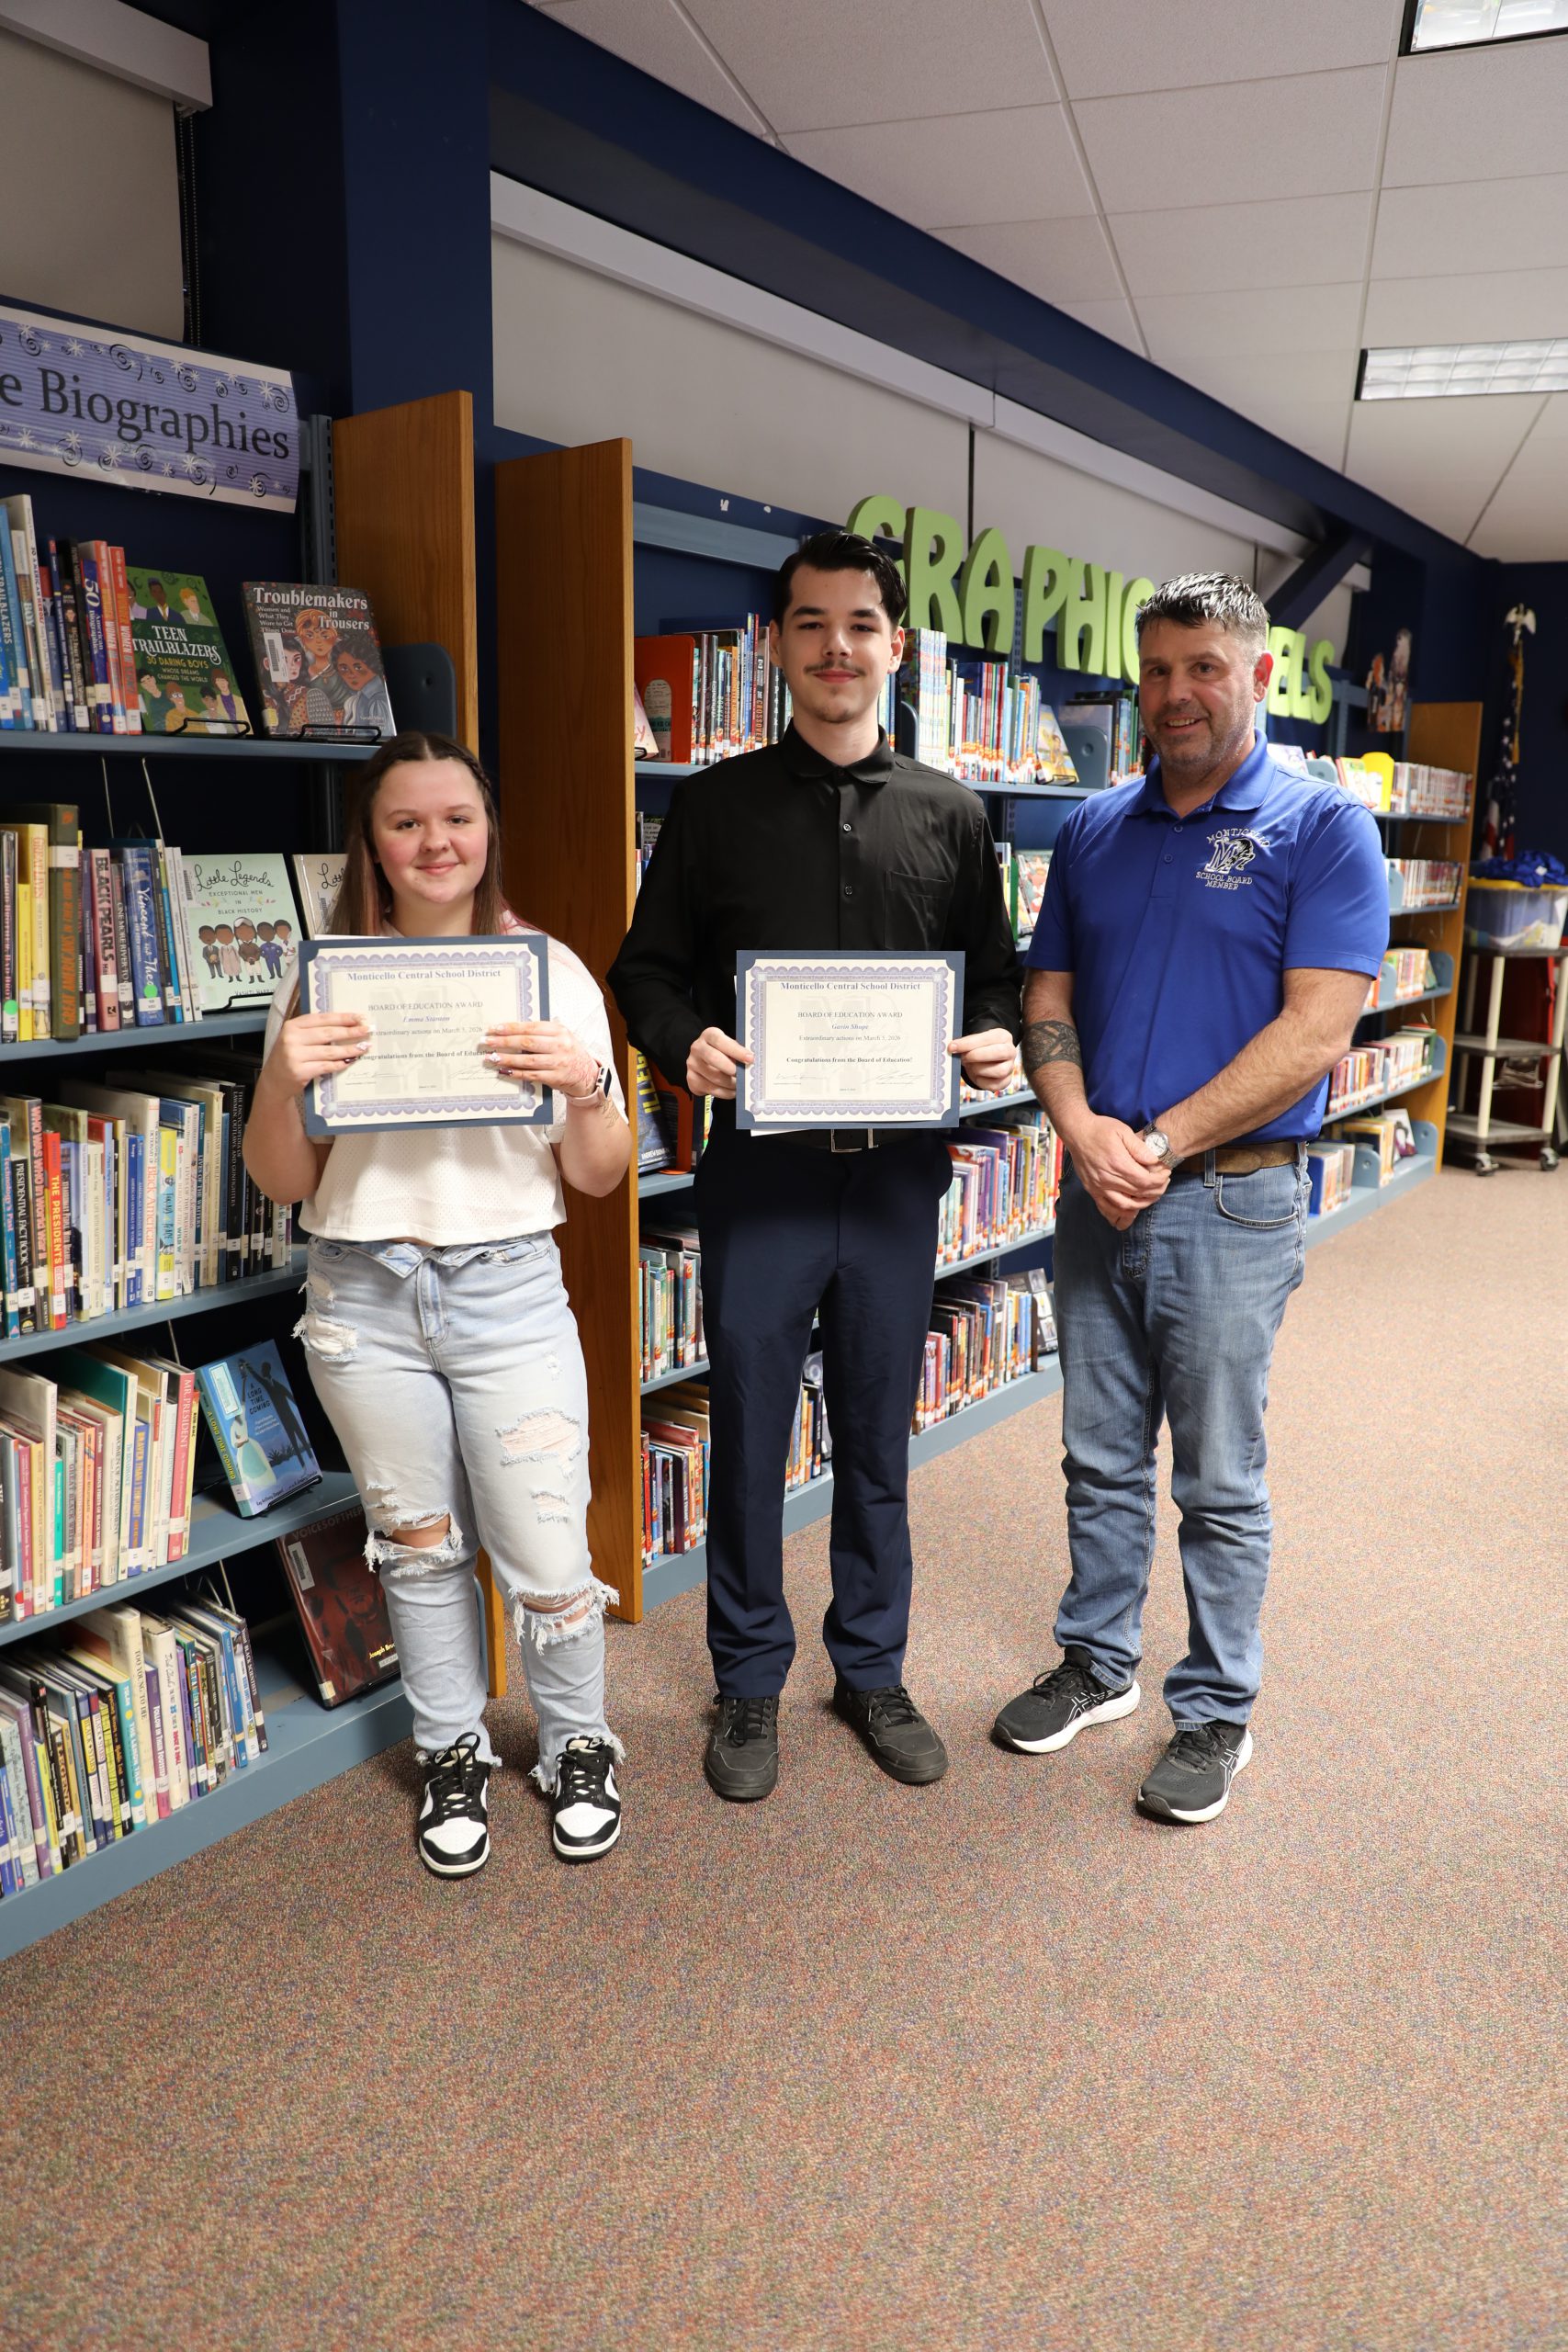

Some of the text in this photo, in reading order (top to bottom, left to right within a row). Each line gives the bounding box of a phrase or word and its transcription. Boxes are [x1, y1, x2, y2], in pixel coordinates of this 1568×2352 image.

[38, 368, 289, 459] Biographies
[32, 558, 40, 596] AMERICAN
[85, 578, 100, 607] 50
[253, 587, 368, 610] Troublemakers
[24, 603, 34, 627] BOY
[318, 616, 369, 630] Trousers
[329, 609, 338, 618] in
[105, 621, 117, 649] WOMEN
[120, 626, 131, 652] WOMEN
[152, 626, 187, 642] TEEN
[133, 639, 221, 664] TRAILBLAZERS
[147, 655, 209, 670] 30 DARING BOYS
[1207, 828, 1270, 846] MONTICELLO
[32, 837, 46, 869] GREAT
[96, 857, 111, 904] BLACK
[194, 860, 275, 892] Little Legends
[1196, 872, 1253, 885] SCHOOL BOARD
[1205, 880, 1239, 890] MEMBER
[137, 888, 153, 937] Vincent
[98, 908, 114, 961] PEARLS
[118, 921, 126, 944] MORE
[61, 934, 76, 989] AMERICANS
[119, 944, 128, 967] RIVER
[120, 967, 129, 980] TO
[347, 969, 501, 981] Monticello Central School District
[781, 982, 920, 990] Monticello Central School District
[367, 1002, 395, 1012] BOARD
[396, 1001, 407, 1010] OF
[408, 1001, 453, 1010] EDUCATION
[30, 1105, 47, 1248] WHO WAS WHO in World War
[51, 1175, 60, 1195] THE
[4, 1157, 15, 1232] Technology's Past
[17, 1163, 28, 1264] PRESIDENTIAL FACT BOOK
[145, 1166, 158, 1250] Black Americans
[52, 1200, 62, 1264] PRESIDENTS
[183, 1379, 191, 1398] MR.
[247, 1387, 262, 1398] LONG
[249, 1400, 271, 1415] COMING
[251, 1396, 265, 1405] TIME
[180, 1398, 191, 1448] PRESIDENT
[209, 1417, 220, 1435] LONG
[216, 1437, 225, 1453] TIME
[292, 1518, 328, 1541] VOICES
[369, 1645, 385, 1658] Joseph
[134, 1649, 147, 1719] TOO YOUNG TO DIE
[248, 1664, 257, 1696] SCIENTISTS
[152, 1705, 161, 1727] FOLLOW
[170, 1705, 177, 1713] 25
[93, 1714, 102, 1736] BLACK
[83, 1719, 96, 1773] BLACK STARS
[96, 1740, 106, 1762] STARS
[155, 1735, 164, 1751] THEIR
